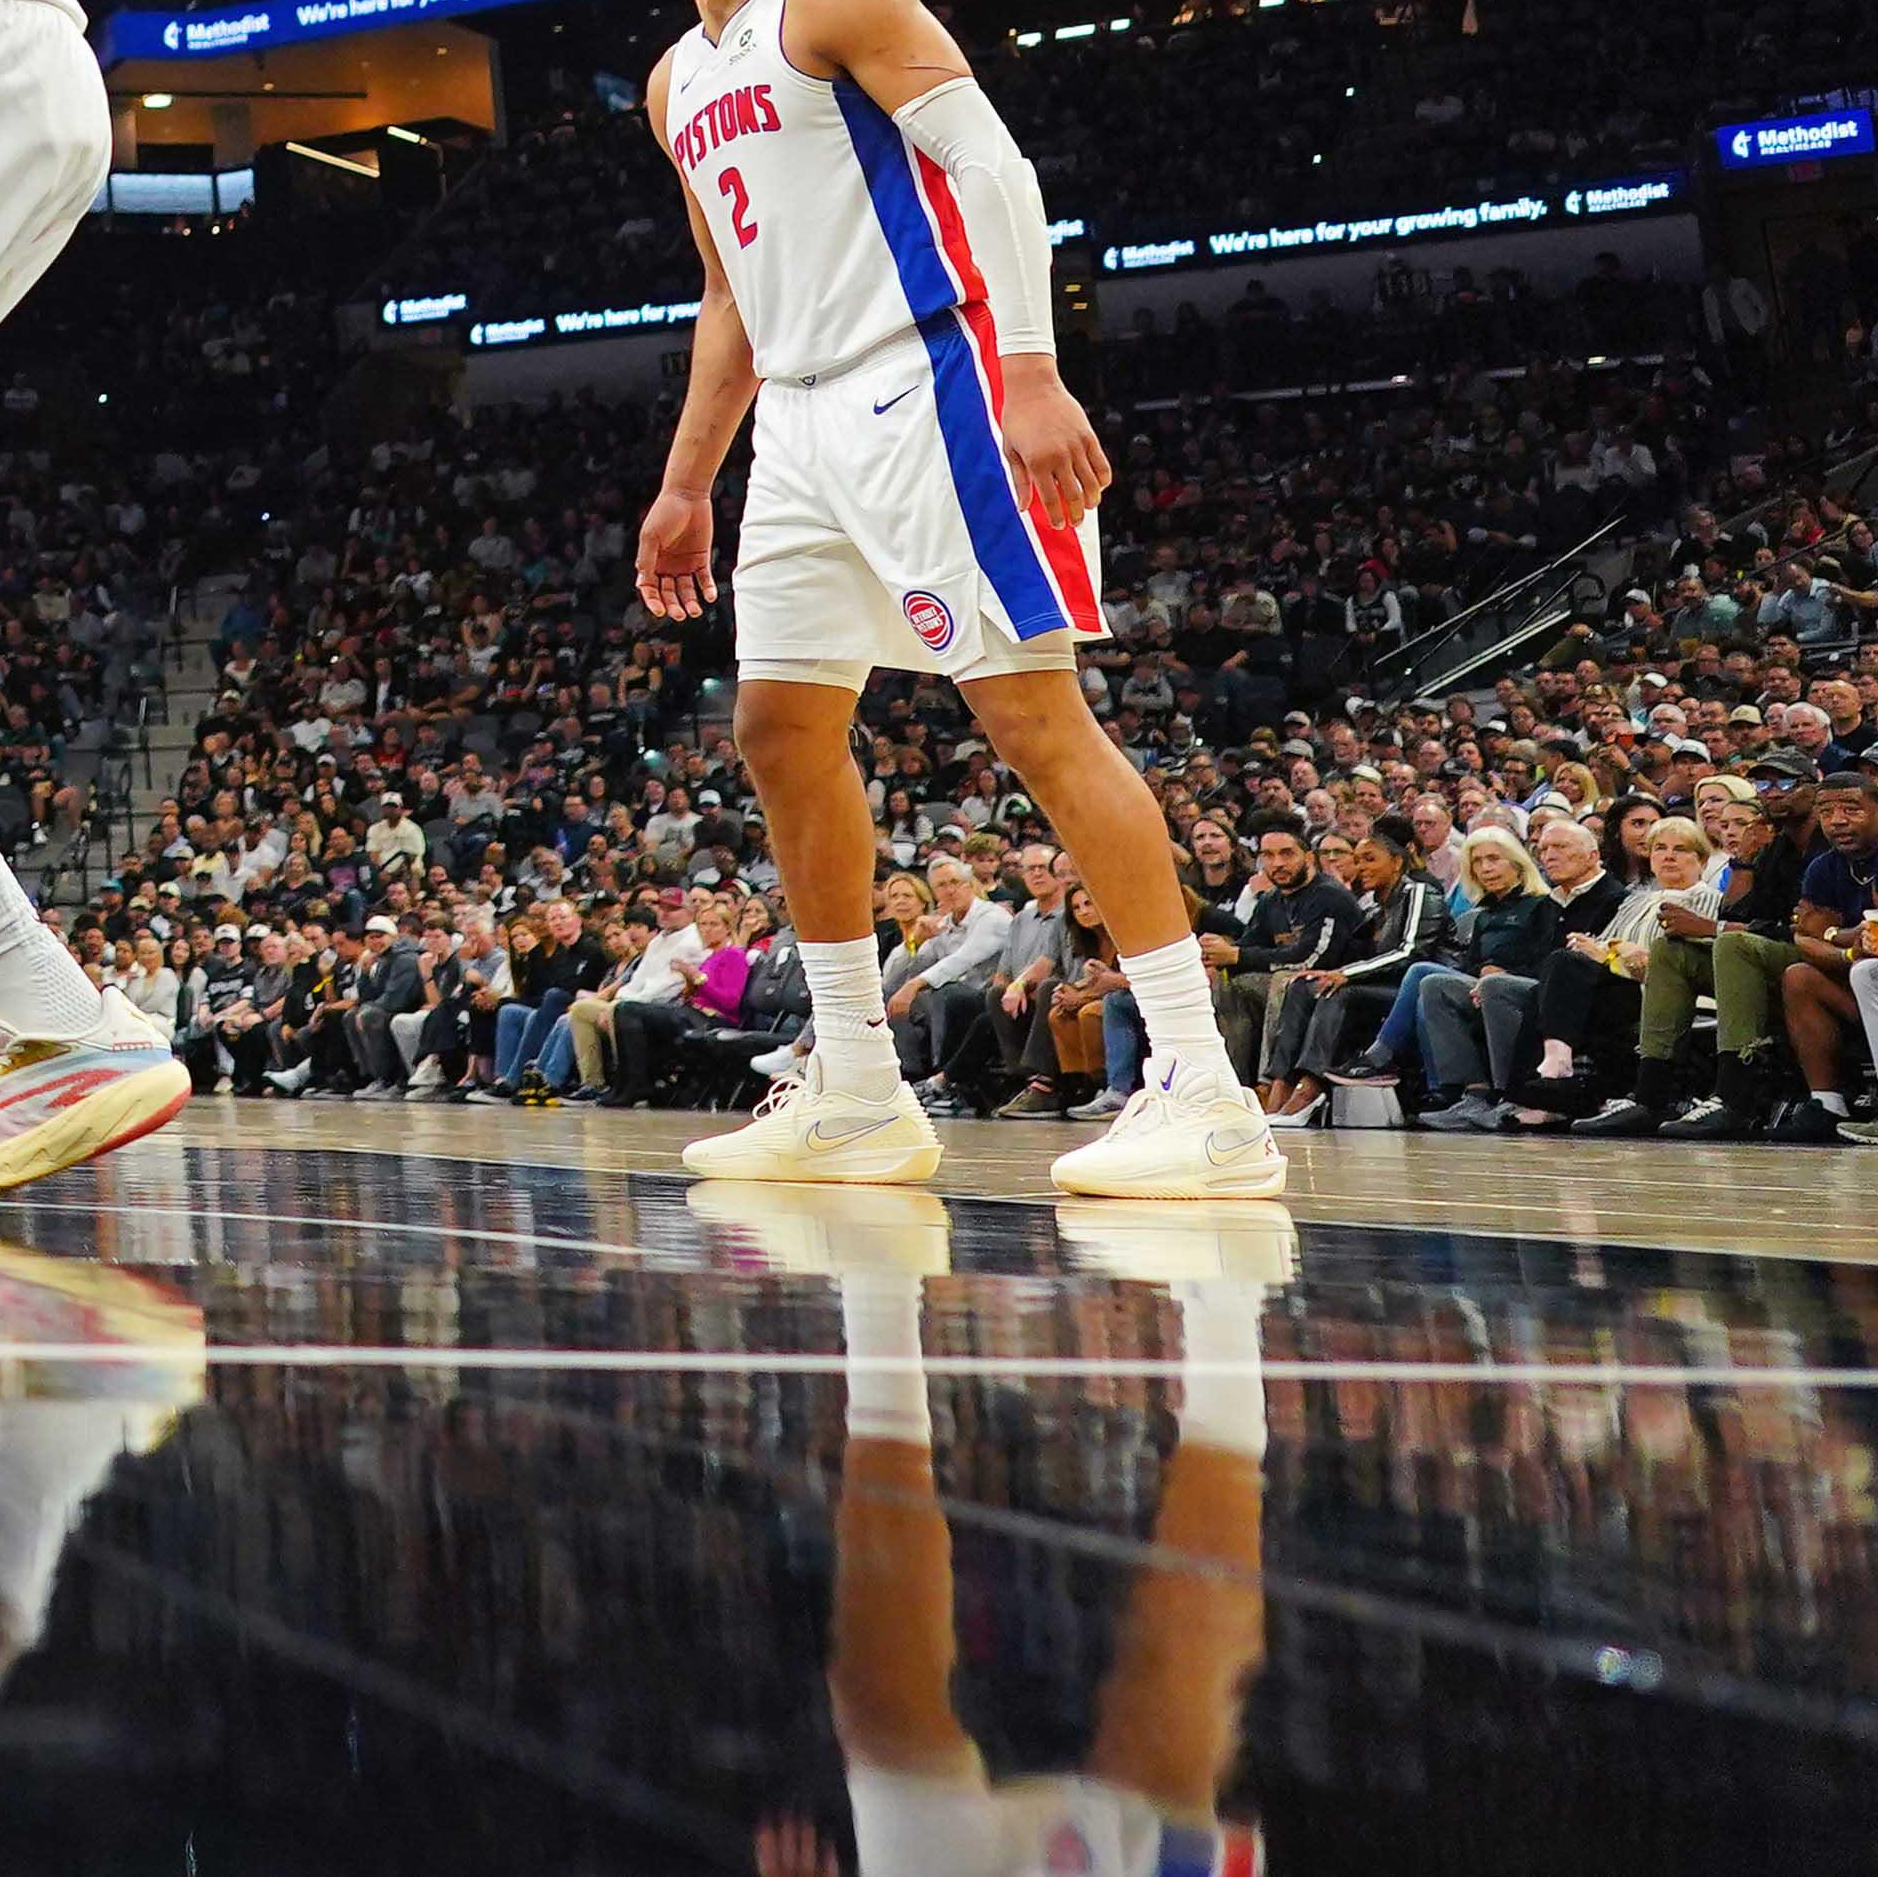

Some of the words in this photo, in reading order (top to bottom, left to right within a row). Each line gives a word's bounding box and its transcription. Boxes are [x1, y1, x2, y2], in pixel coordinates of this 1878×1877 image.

[297, 0, 348, 26] We're
[673, 84, 782, 185] PISTONS
[1756, 119, 1858, 148] Methodist
[717, 166, 758, 250] 2
[1586, 182, 1669, 205] Methodist
[1208, 231, 1268, 255] We're
[1269, 226, 1315, 248] here
[1315, 221, 1346, 242] for
[1346, 215, 1393, 242] your
[1393, 207, 1478, 237] growing
[1479, 196, 1547, 224] family.
[555, 312, 604, 334] We're
[604, 307, 641, 328] here
[641, 303, 667, 323] for
